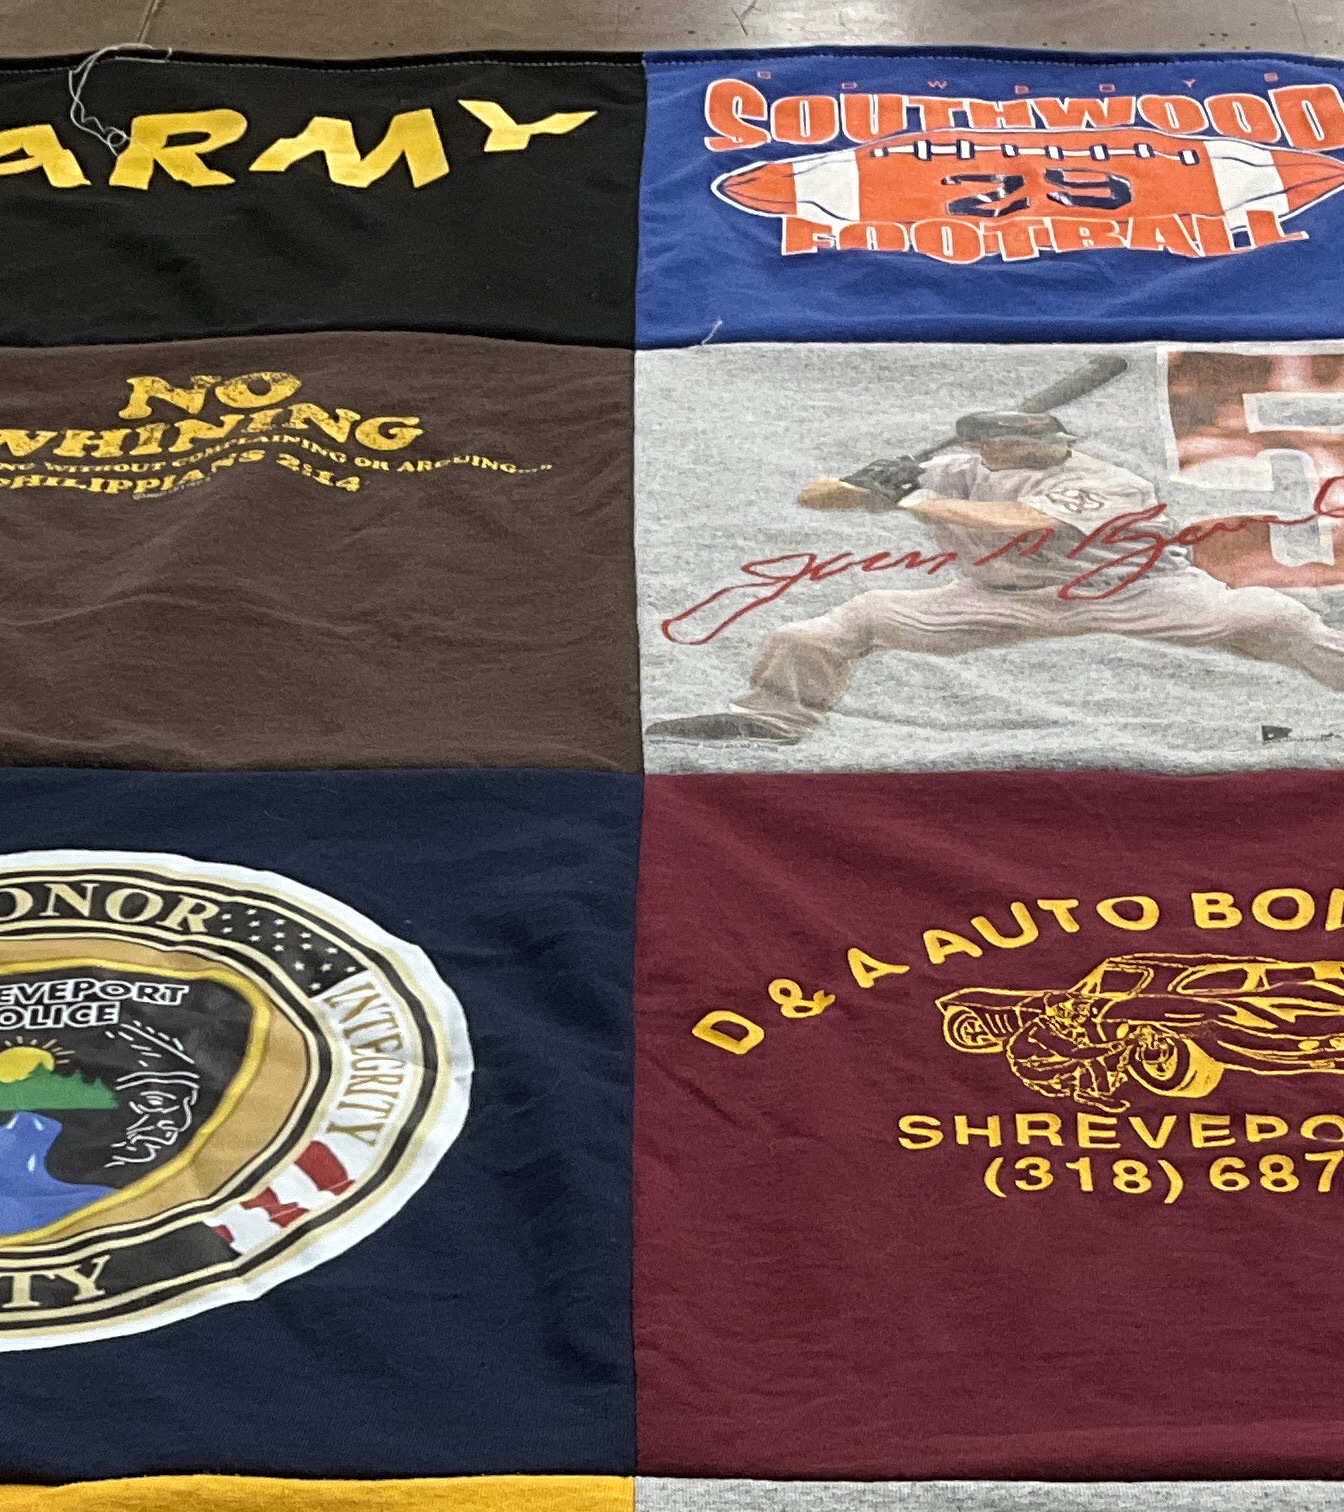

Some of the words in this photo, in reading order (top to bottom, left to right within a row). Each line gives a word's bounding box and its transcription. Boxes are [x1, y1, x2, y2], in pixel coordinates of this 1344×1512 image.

[781, 210, 1309, 263] FOOTBALL
[118, 371, 303, 418] NO
[354, 455, 390, 471] OR
[692, 1010, 764, 1056] D
[768, 979, 836, 1019] &
[849, 948, 910, 990] A
[922, 895, 1161, 963] AUTO
[322, 981, 405, 1147] INTEGRITY
[983, 1156, 1184, 1203] (318)
